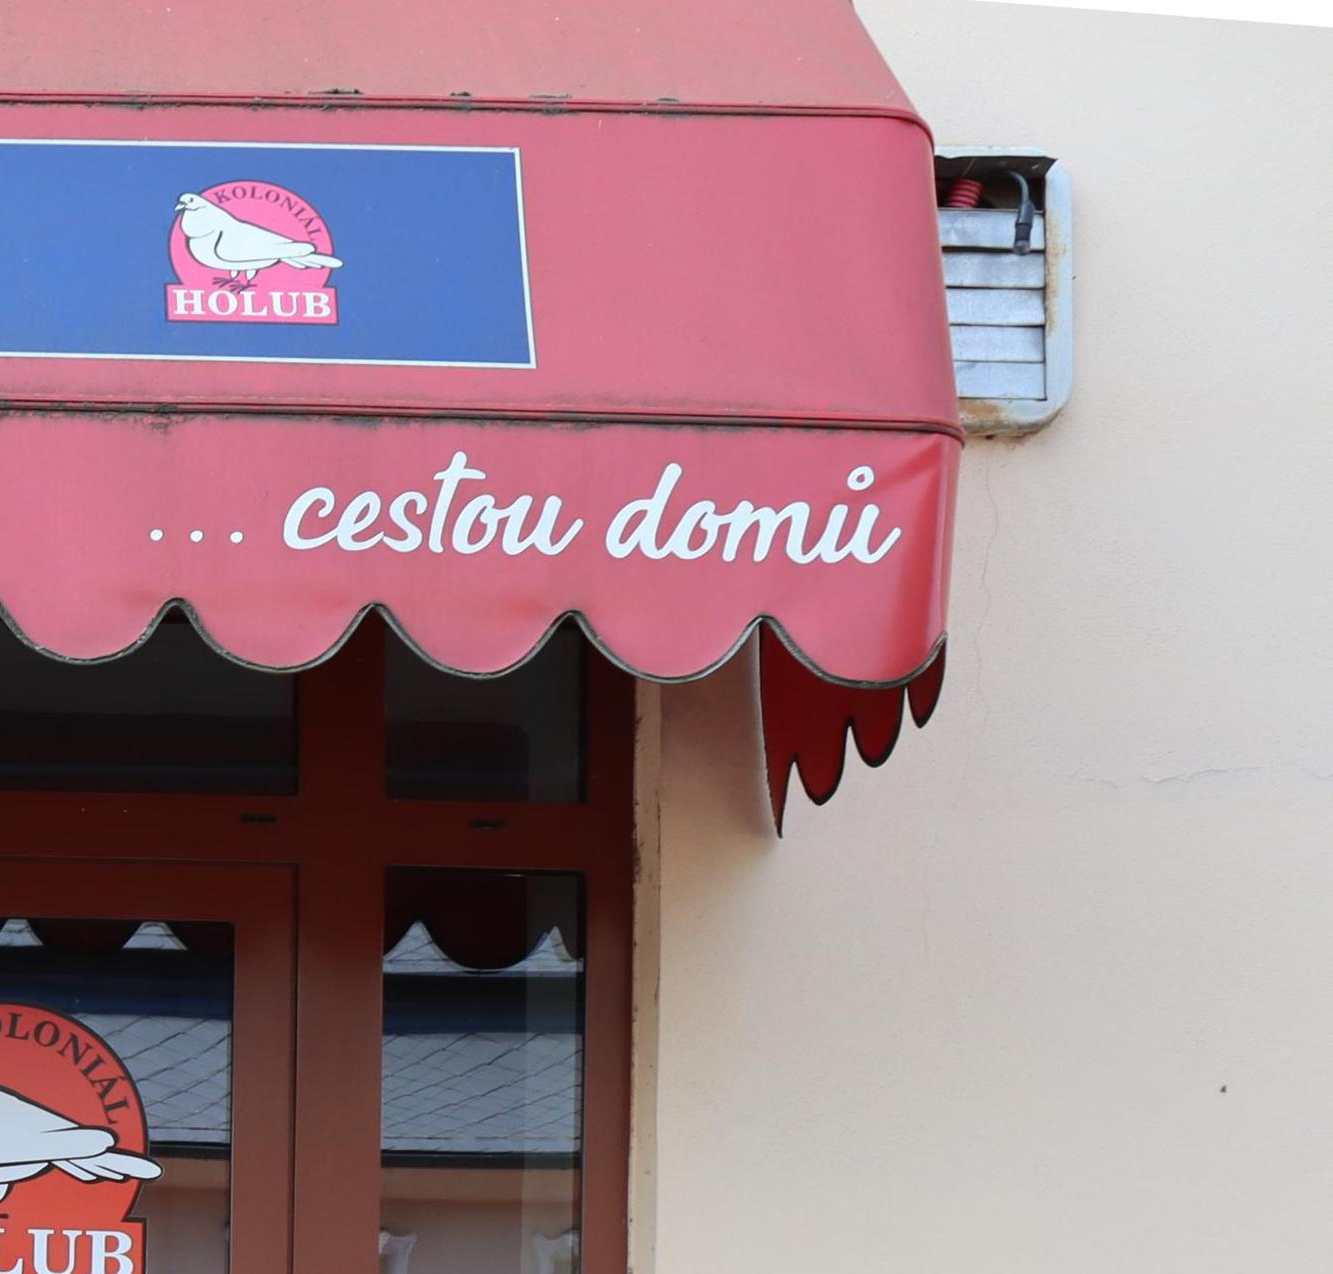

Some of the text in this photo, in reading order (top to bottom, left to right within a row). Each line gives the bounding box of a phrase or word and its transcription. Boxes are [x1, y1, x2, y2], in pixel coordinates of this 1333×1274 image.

[213, 186, 322, 241] KOLONIÁL
[173, 289, 331, 317] HOLUB
[283, 452, 584, 555] cestou
[607, 463, 902, 565] domů
